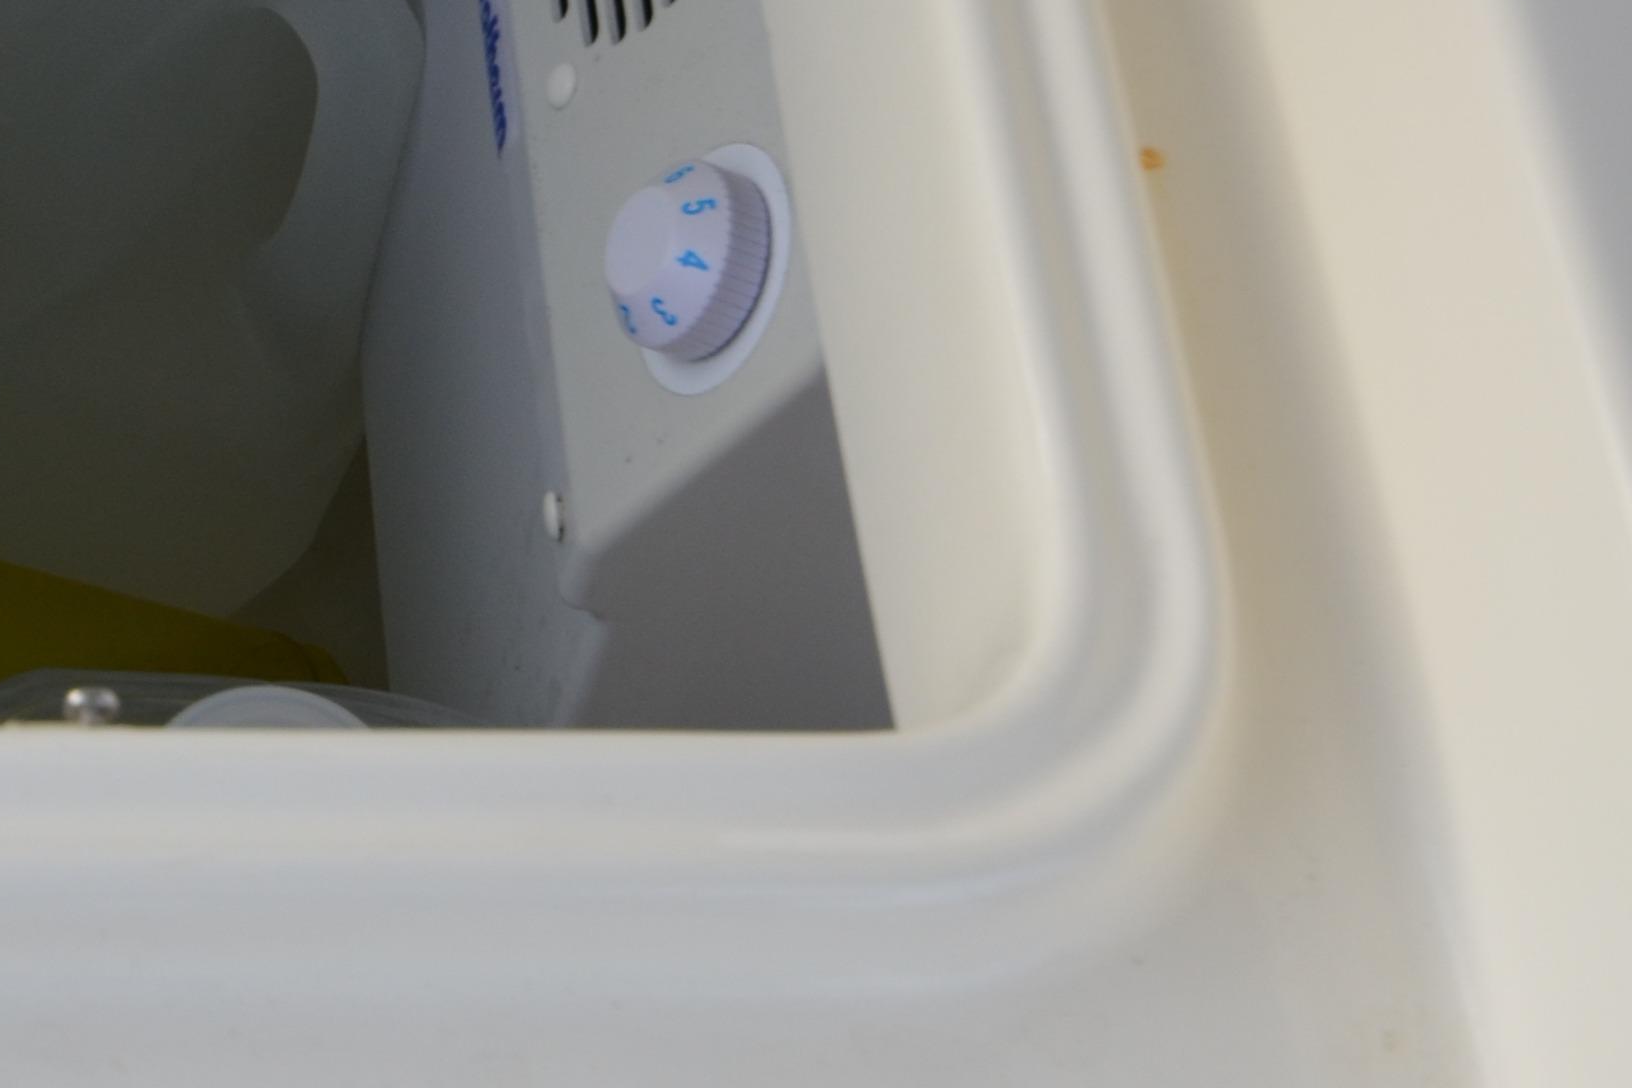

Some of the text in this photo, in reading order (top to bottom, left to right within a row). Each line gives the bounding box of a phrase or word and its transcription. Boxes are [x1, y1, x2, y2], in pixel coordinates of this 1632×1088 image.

[681, 198, 717, 215] 5
[677, 249, 710, 271] 4
[651, 297, 678, 326] 3
